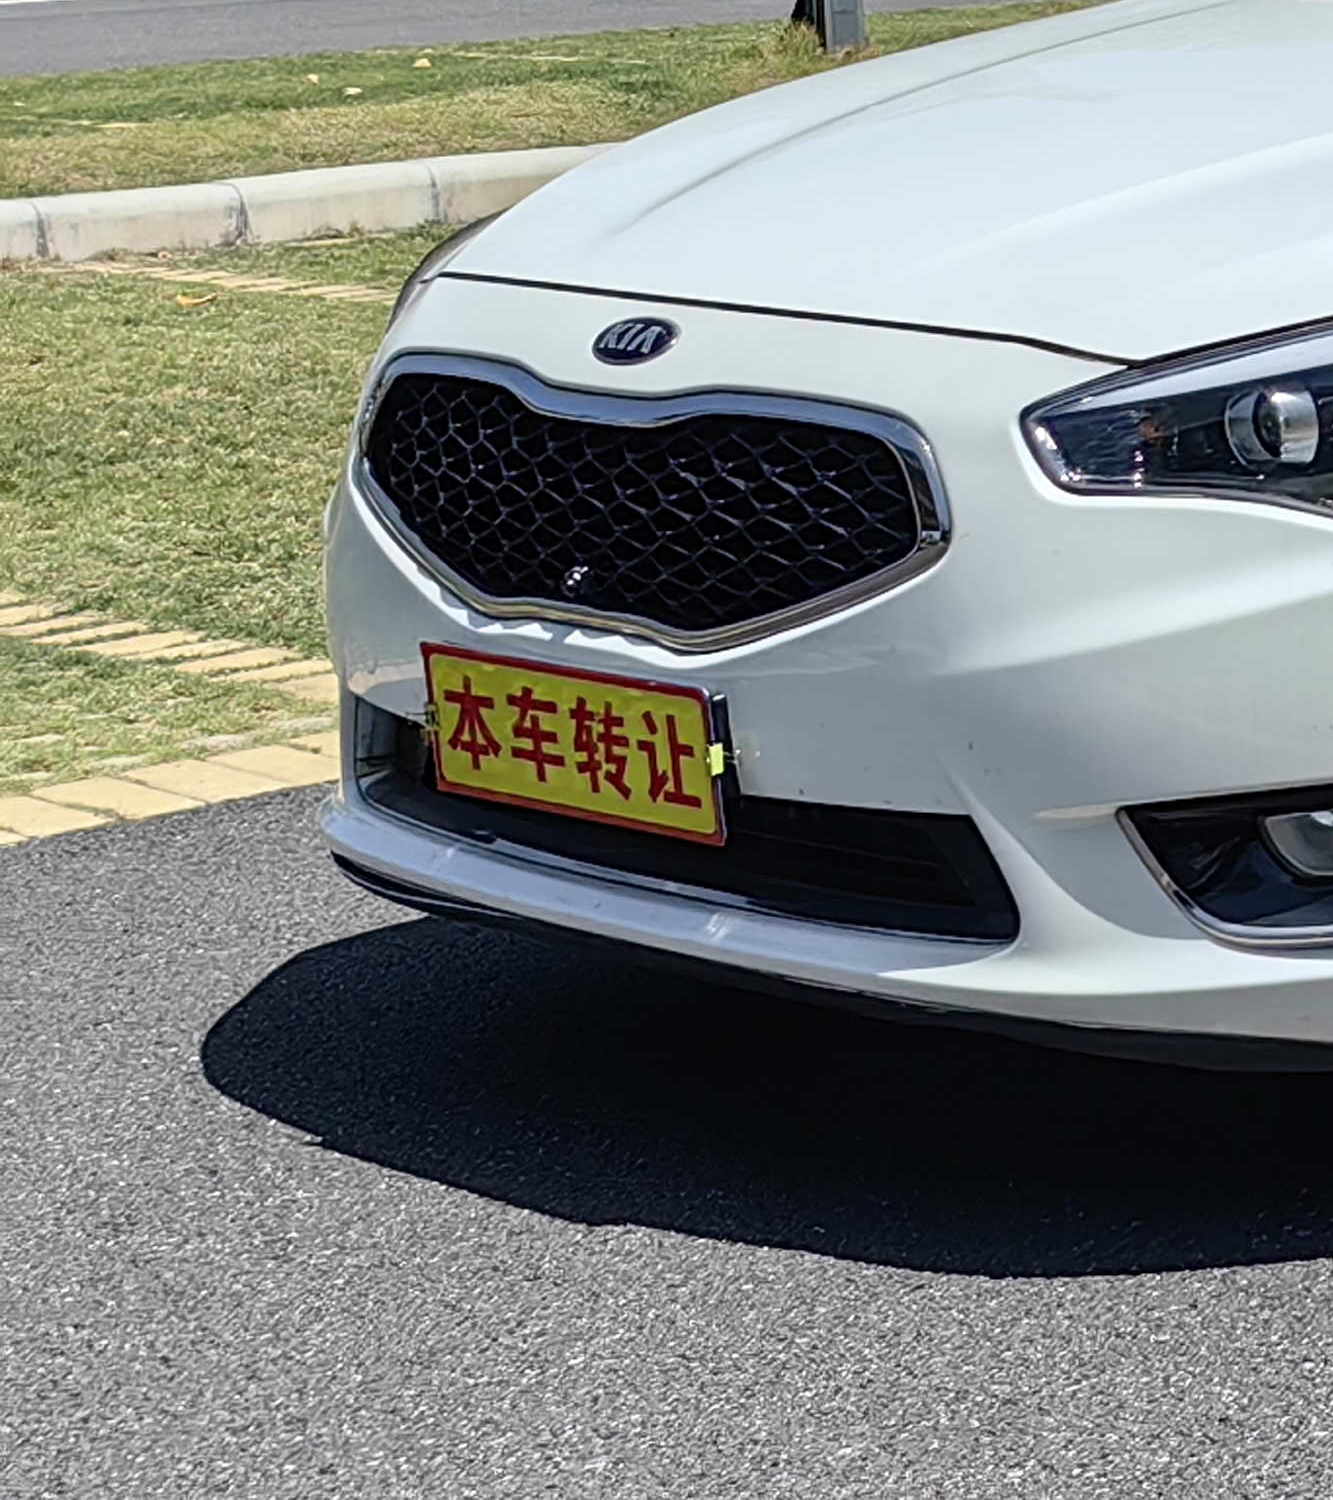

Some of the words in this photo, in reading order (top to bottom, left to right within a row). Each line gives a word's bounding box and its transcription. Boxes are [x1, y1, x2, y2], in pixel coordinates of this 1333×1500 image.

[599, 323, 667, 354] KIA
[443, 675, 702, 809] 本车转让
